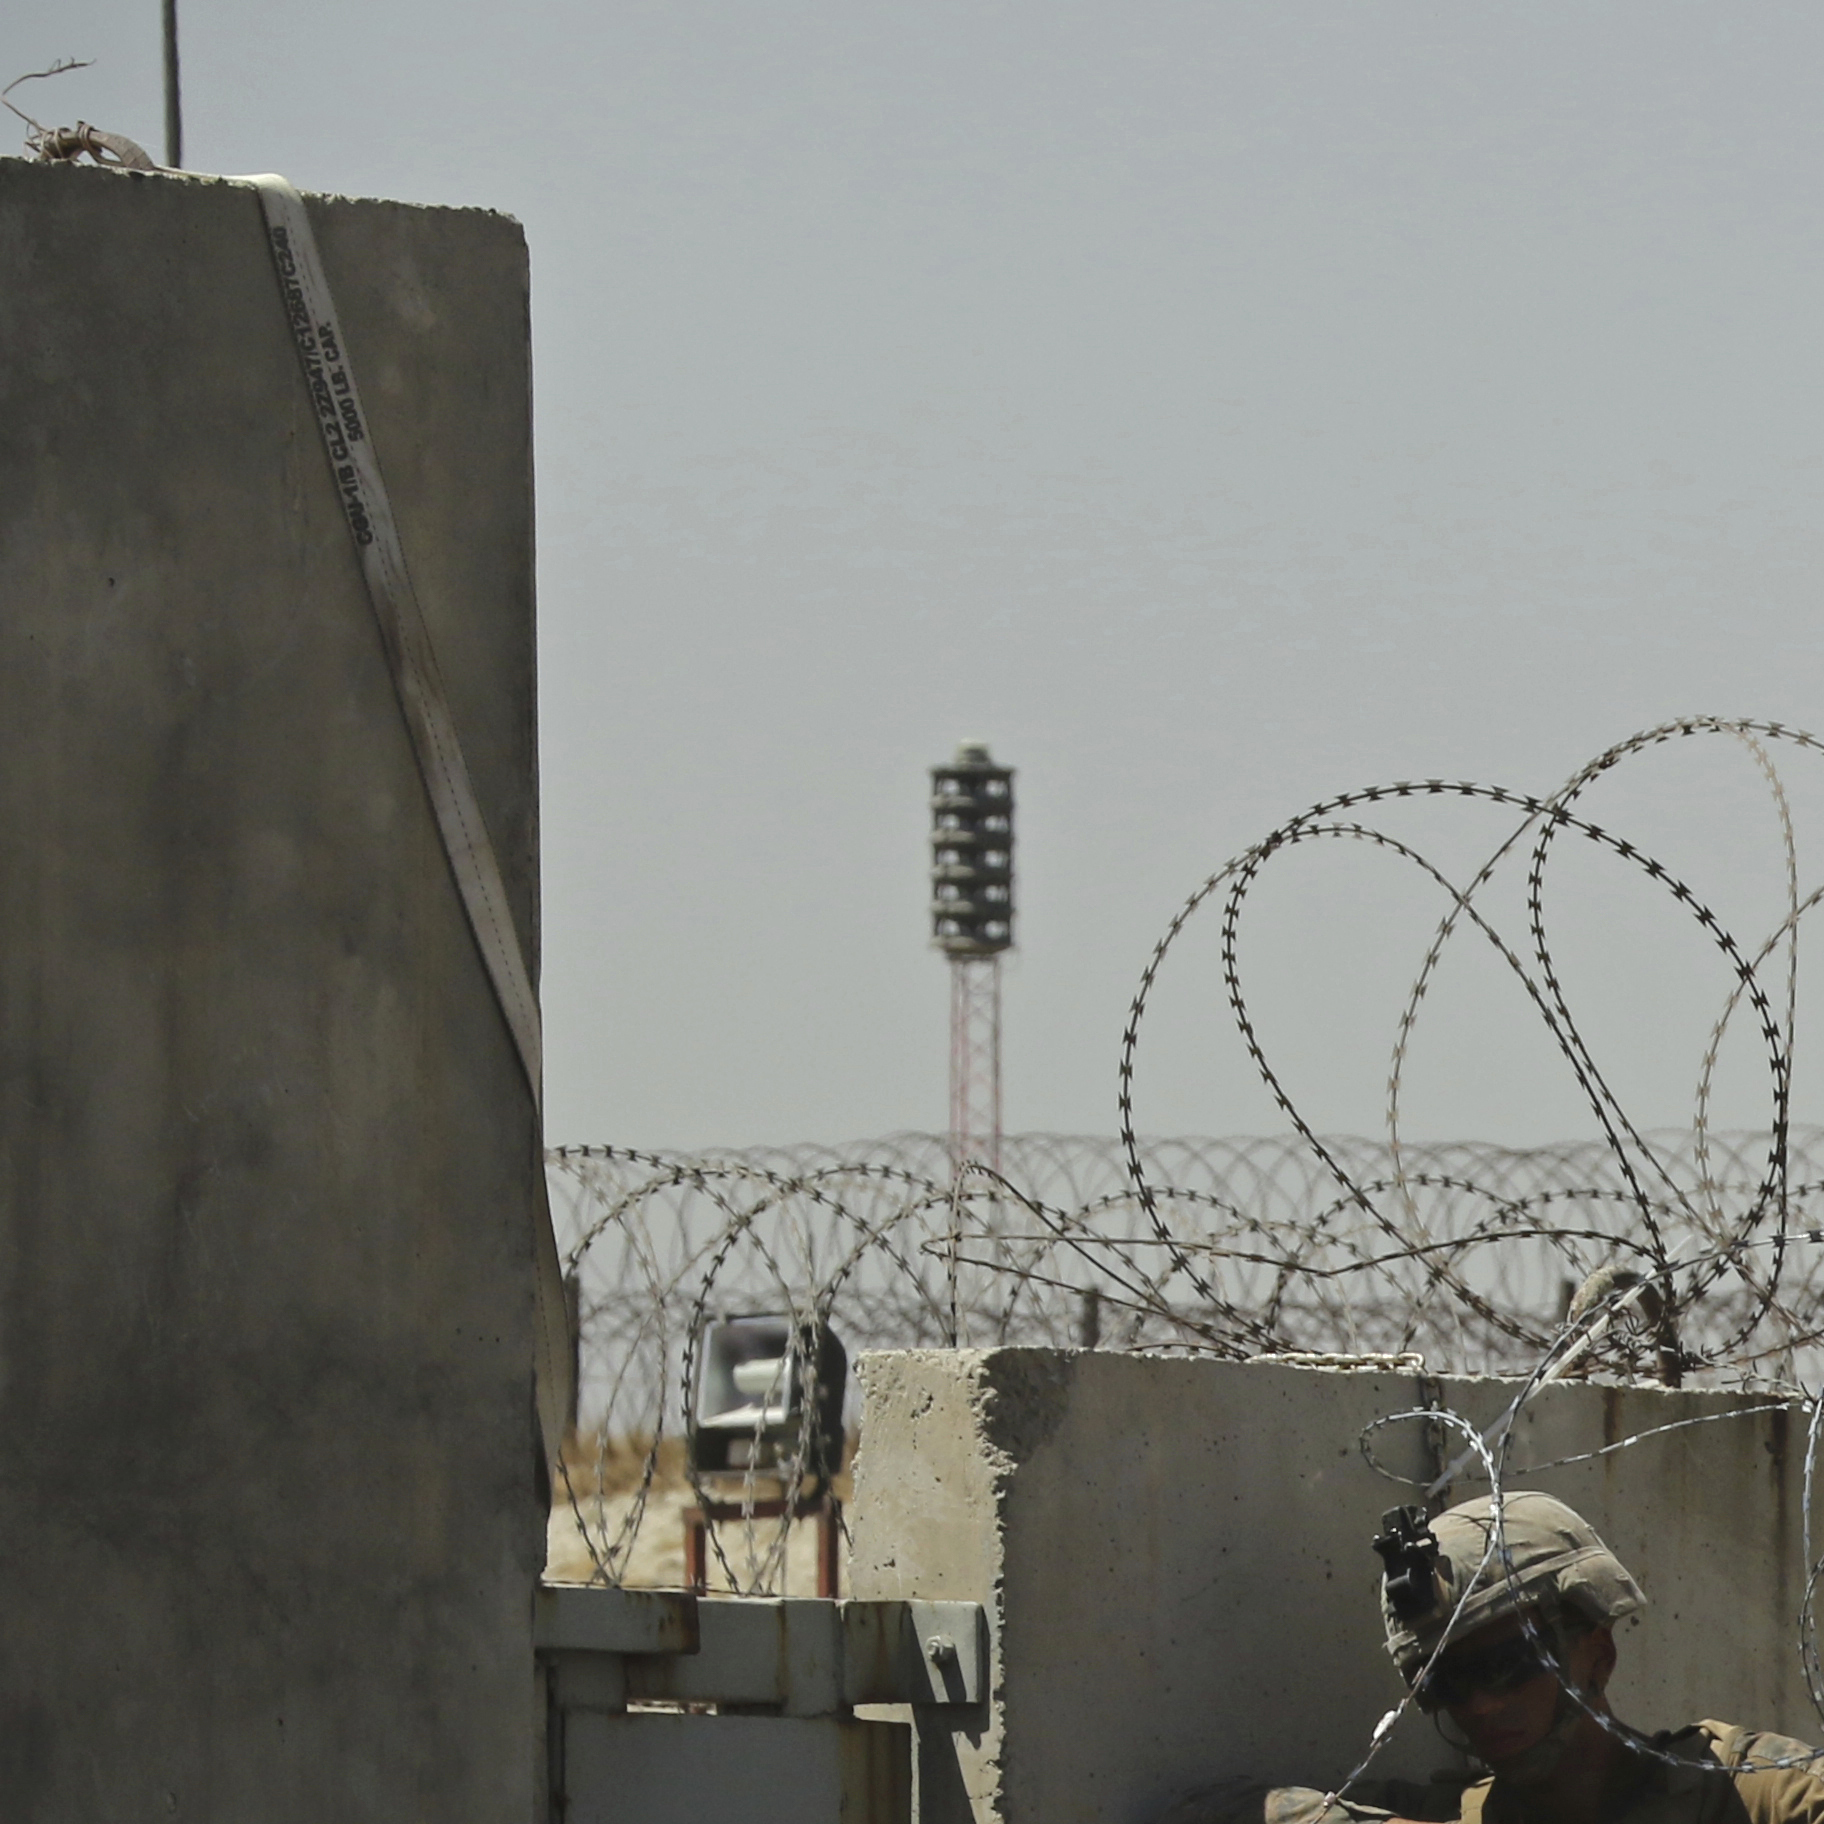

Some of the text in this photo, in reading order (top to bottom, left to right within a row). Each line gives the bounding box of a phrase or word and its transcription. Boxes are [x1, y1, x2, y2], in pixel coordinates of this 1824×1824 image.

[318, 321, 364, 442] 5000 LB. CAP.
[325, 421, 348, 461] CL2
